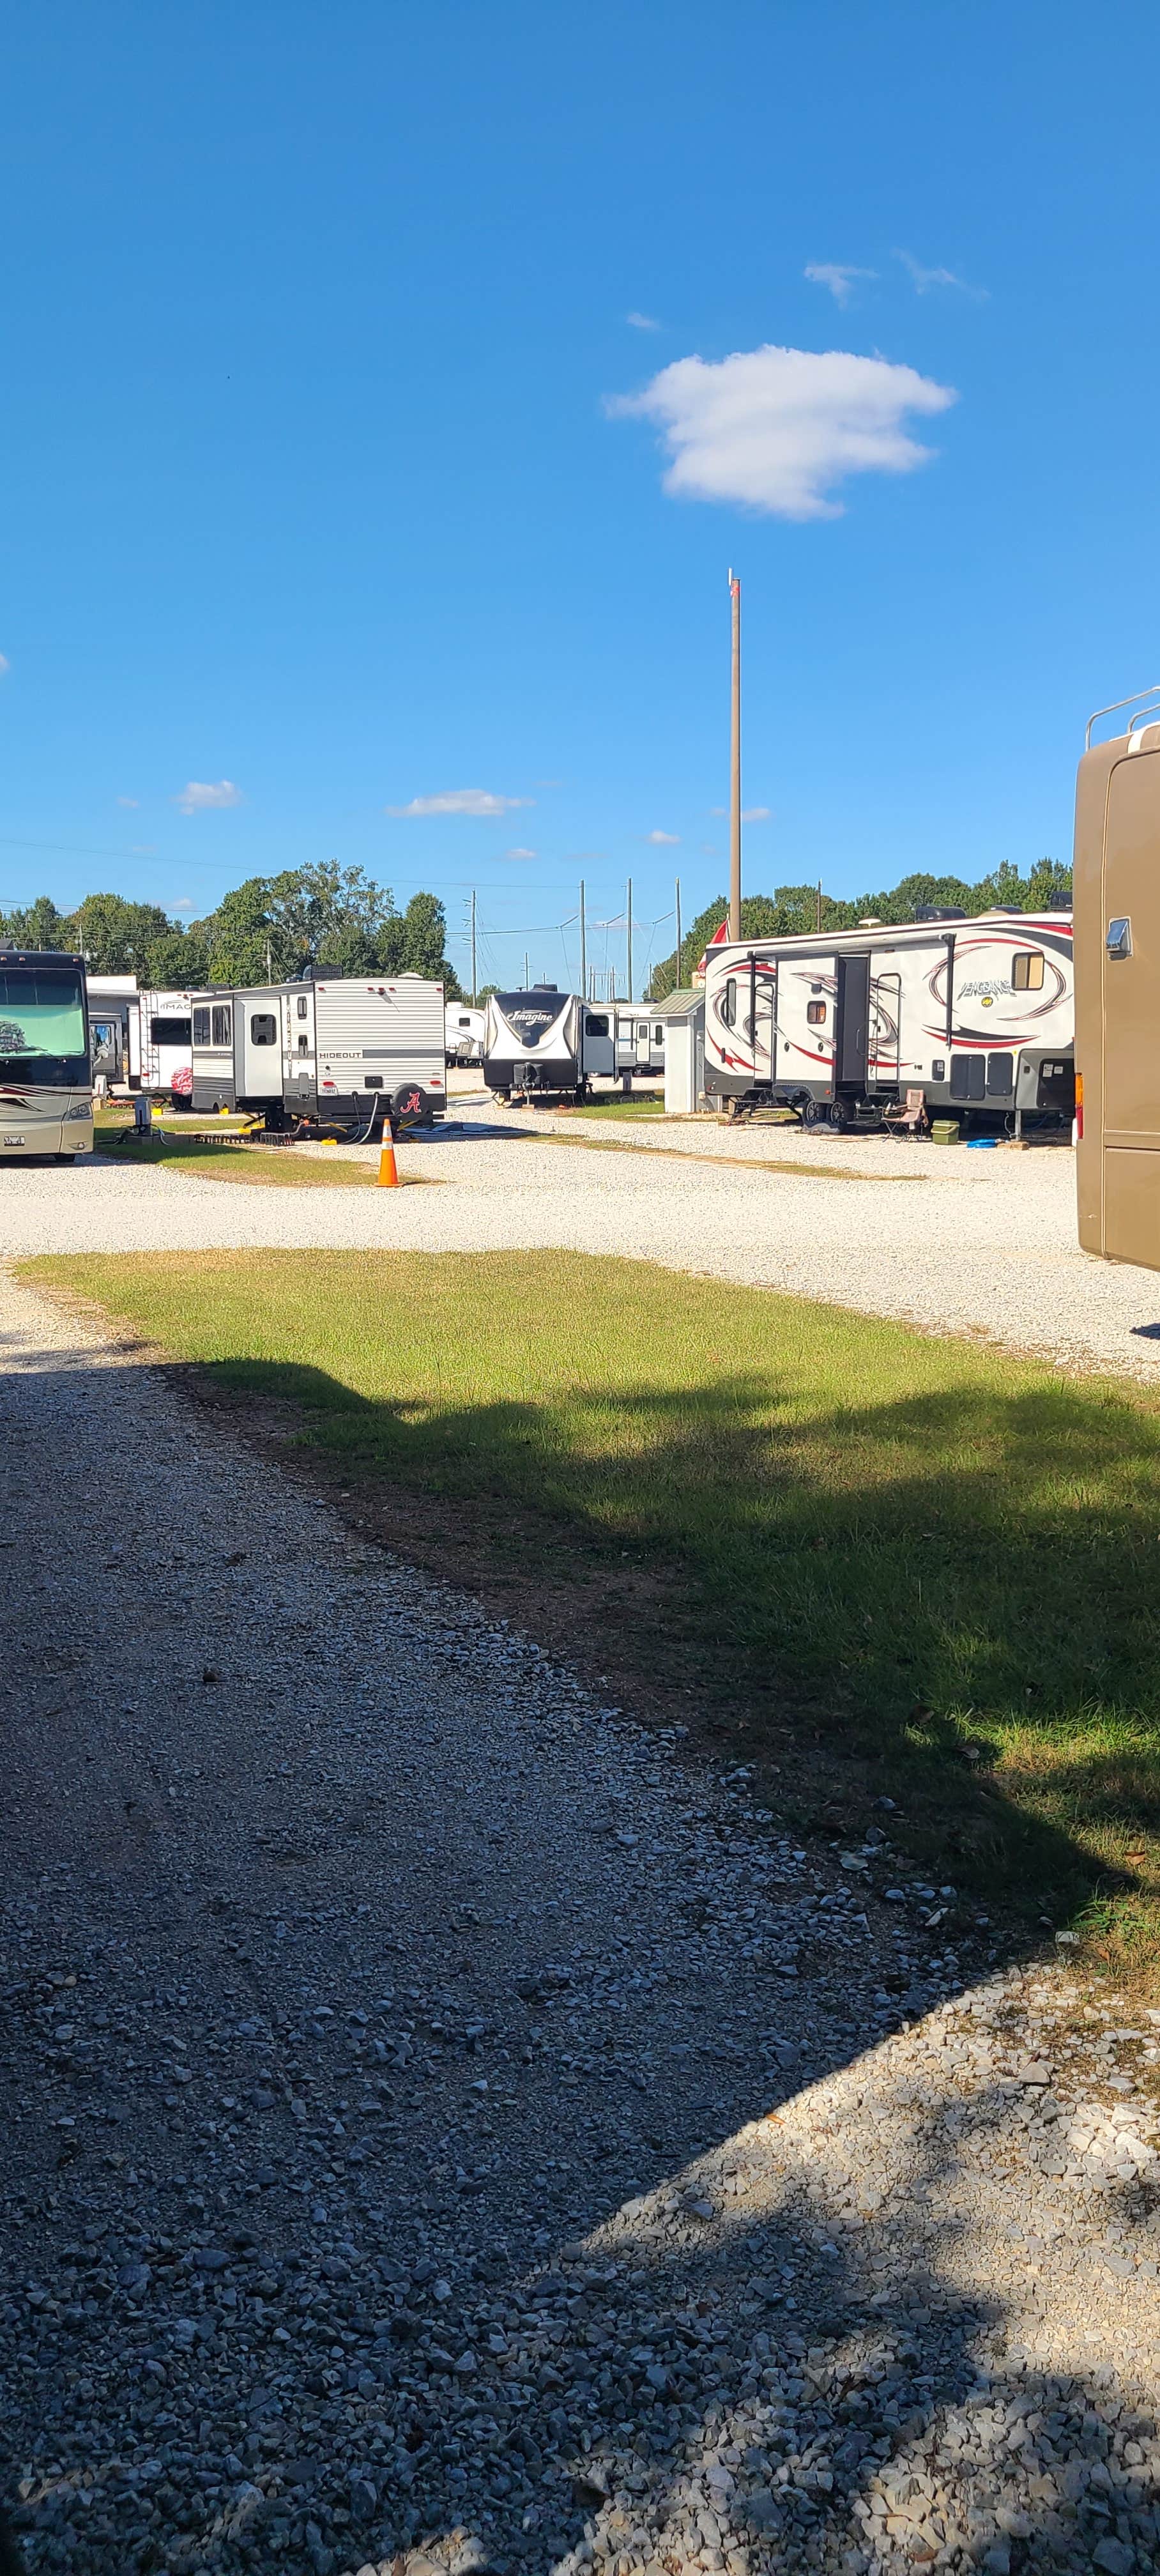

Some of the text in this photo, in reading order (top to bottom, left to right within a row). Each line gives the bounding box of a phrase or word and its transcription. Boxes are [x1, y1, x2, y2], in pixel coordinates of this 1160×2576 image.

[957, 980, 1016, 1000] VENGEANCE
[507, 1010, 553, 1026] Imagine
[400, 1092, 422, 1113] A
